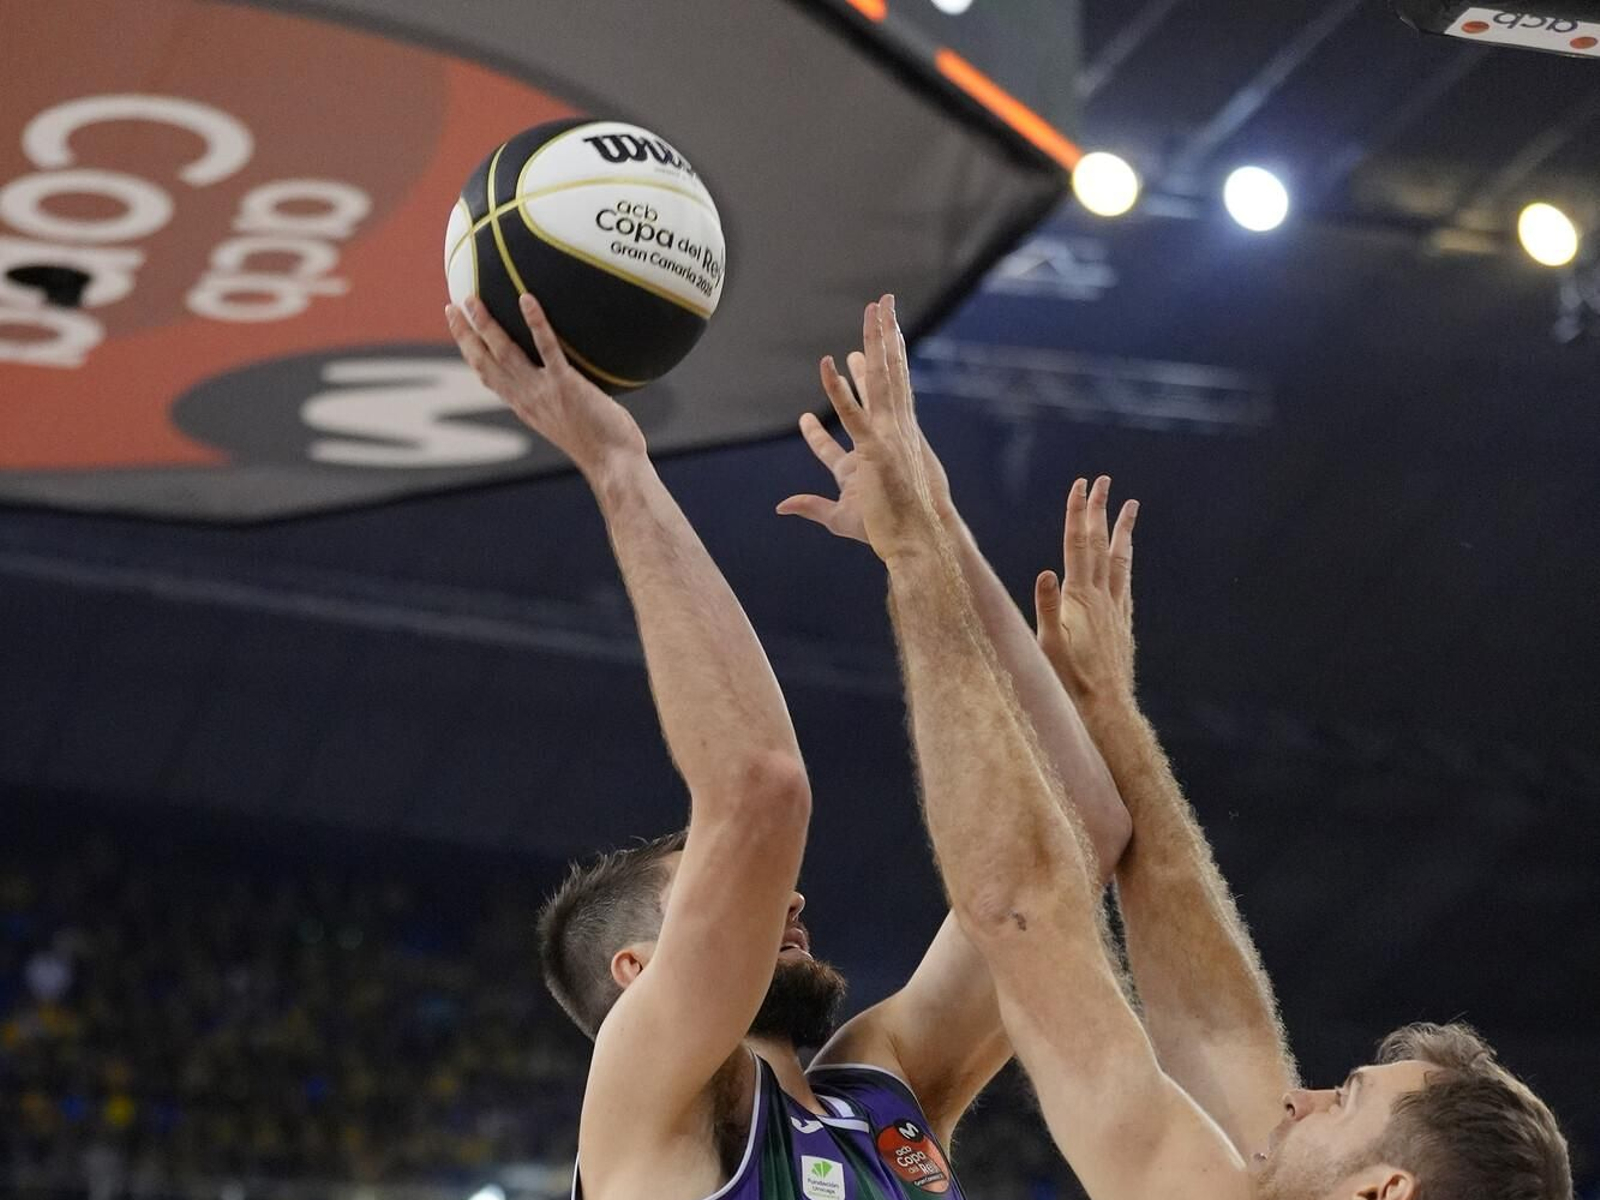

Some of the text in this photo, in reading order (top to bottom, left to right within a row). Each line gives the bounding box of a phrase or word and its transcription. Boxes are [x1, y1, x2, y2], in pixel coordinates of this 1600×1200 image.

[616, 200, 658, 222] acb
[185, 178, 372, 323] acb
[595, 208, 674, 249] Copa
[677, 238, 702, 261] del
[610, 241, 648, 263] Gran
[650, 251, 696, 285] Canaria
[896, 1151, 926, 1167] Copa
